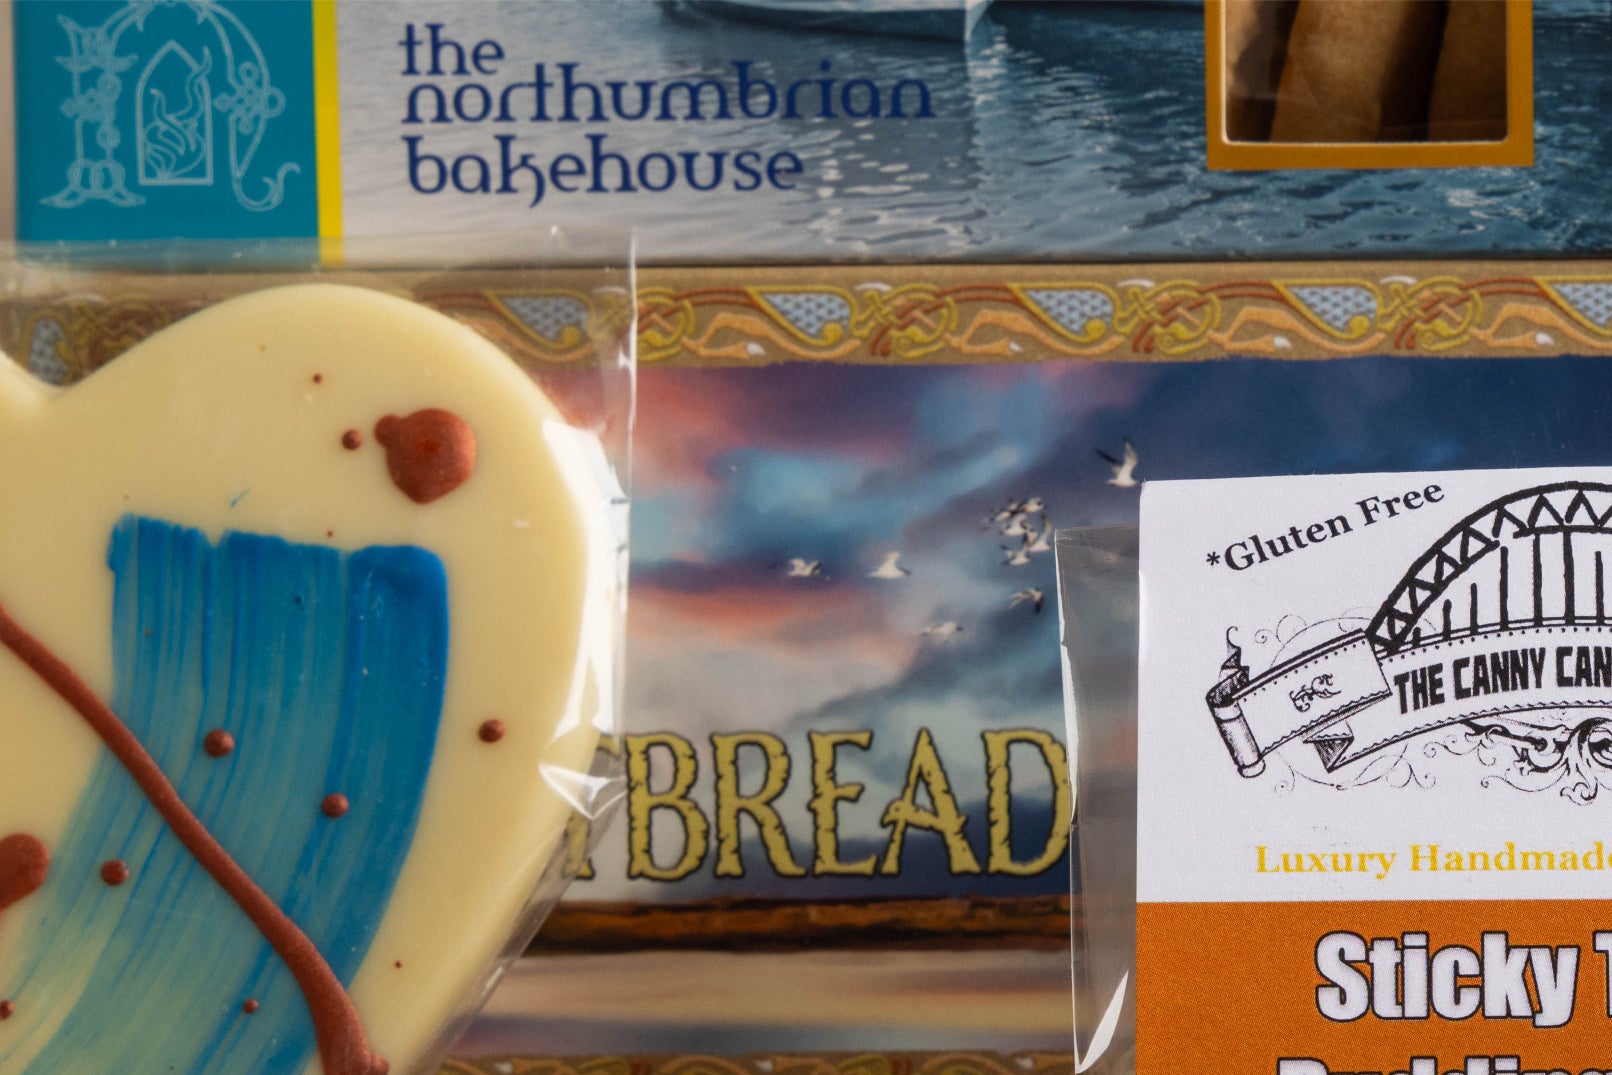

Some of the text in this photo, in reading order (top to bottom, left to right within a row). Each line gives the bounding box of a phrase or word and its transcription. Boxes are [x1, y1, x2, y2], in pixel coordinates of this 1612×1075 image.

[398, 22, 505, 76] the
[400, 59, 938, 124] northumbrian
[400, 133, 804, 208] bakehouse
[1355, 484, 1445, 527] Free
[1393, 662, 1446, 715] THE
[1452, 646, 1547, 701] CANNY
[1254, 845, 1398, 881] Luxury
[1314, 930, 1581, 1028] Sticky
